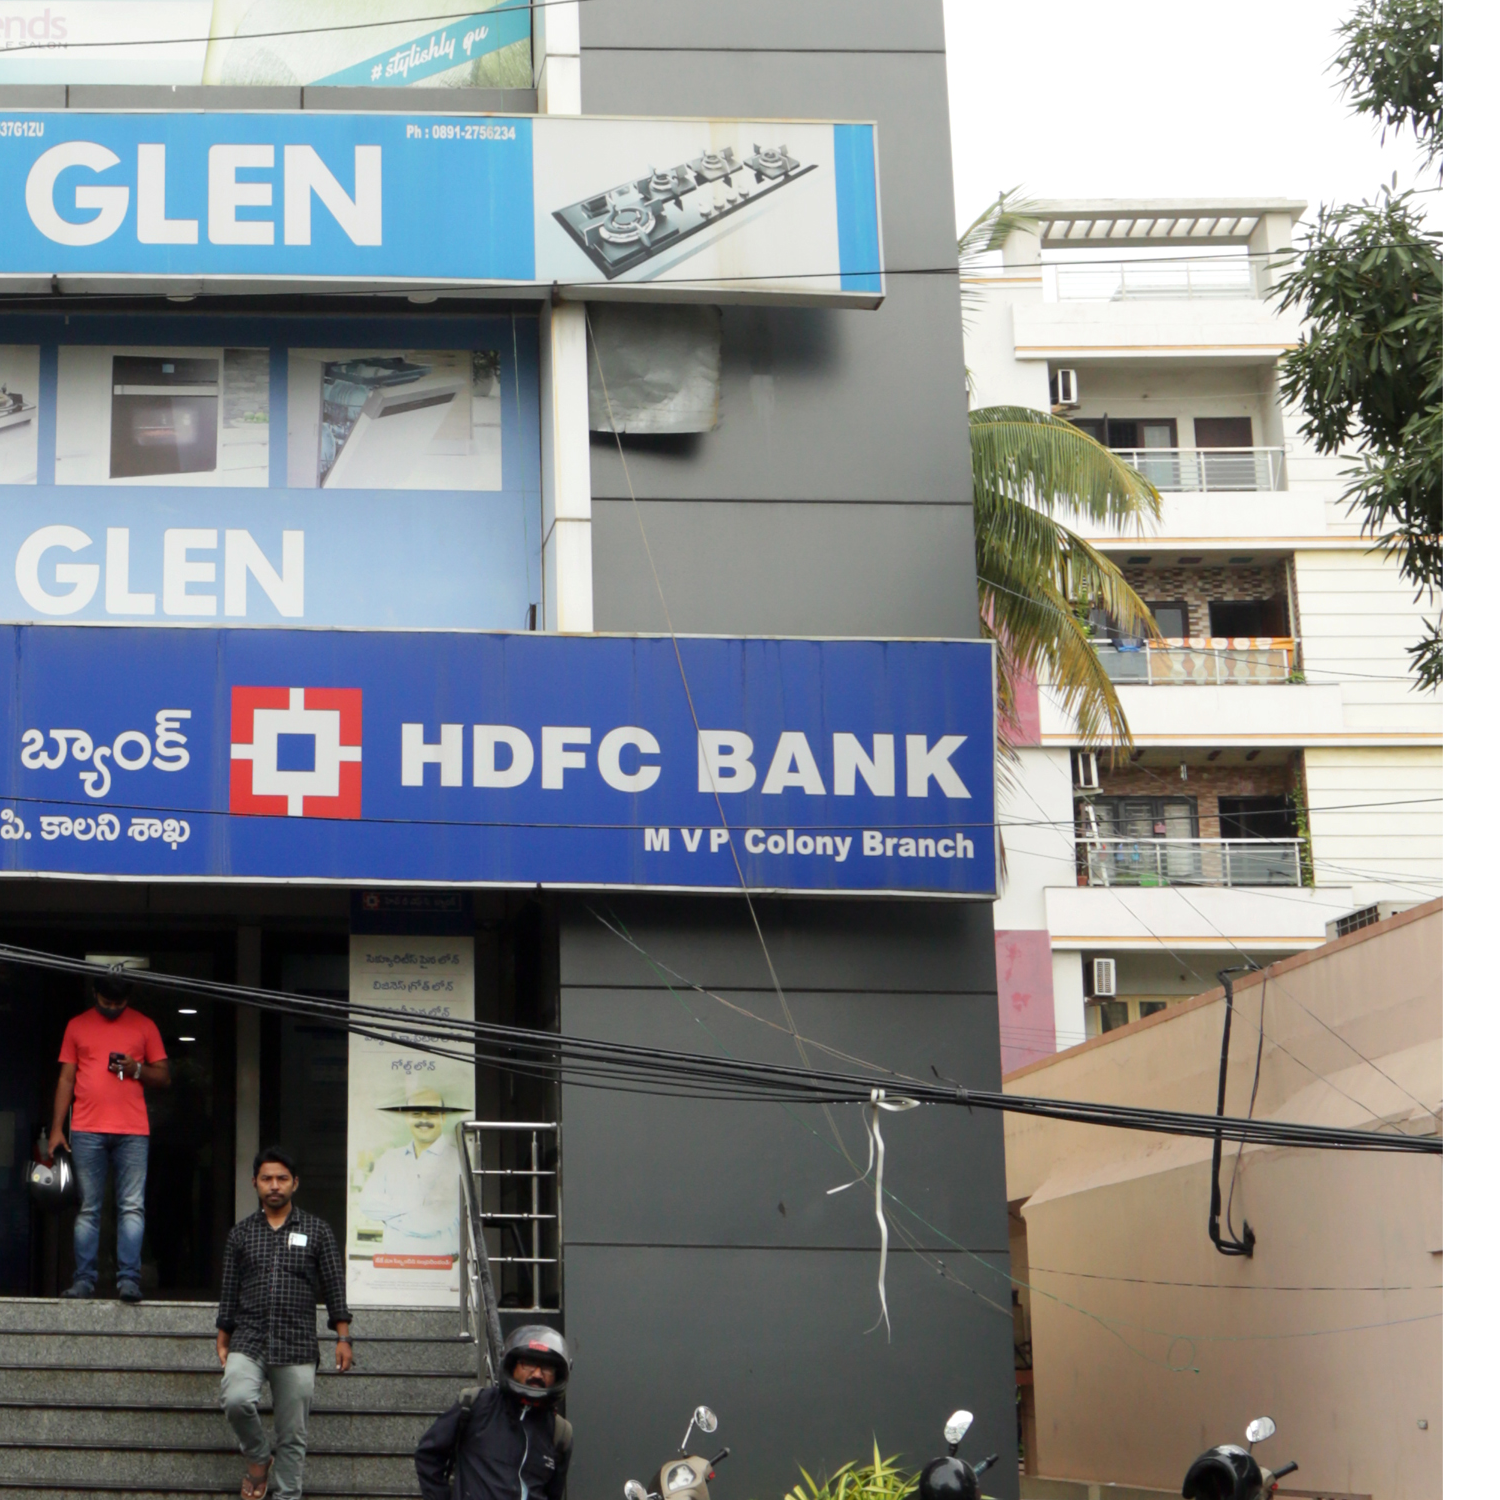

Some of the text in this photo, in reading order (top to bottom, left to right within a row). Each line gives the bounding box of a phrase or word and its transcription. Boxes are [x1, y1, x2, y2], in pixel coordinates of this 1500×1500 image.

[406, 124, 422, 139] Ph
[432, 125, 516, 140] 0891-2756234
[25, 141, 382, 246] GLEN
[15, 525, 305, 618] GLEN
[401, 723, 971, 799] HDFC BANK
[644, 828, 975, 862] M V P Colony Branch
